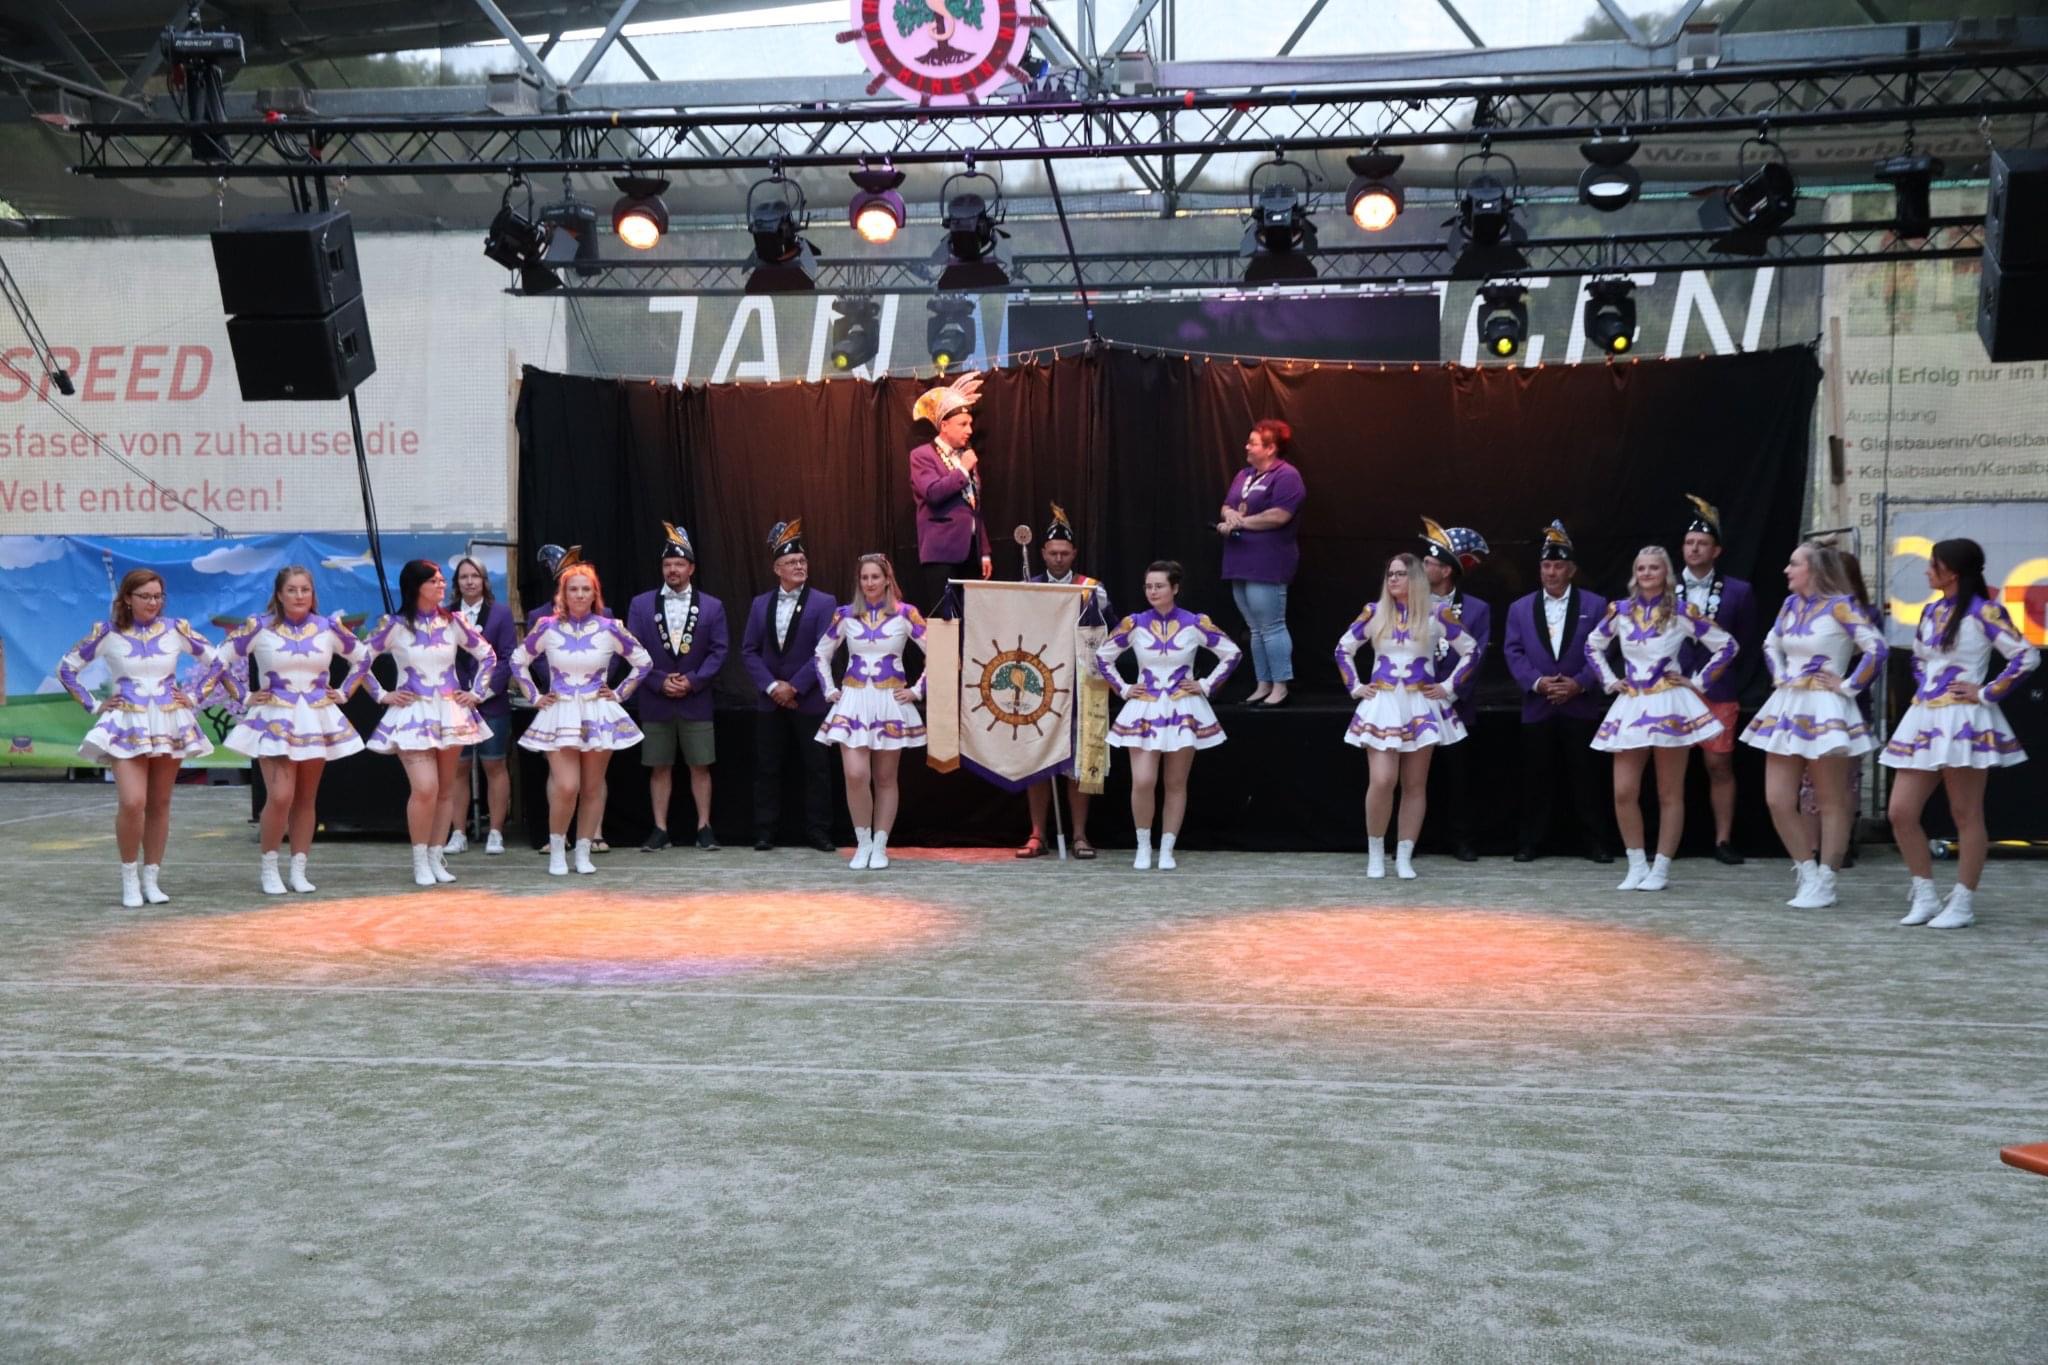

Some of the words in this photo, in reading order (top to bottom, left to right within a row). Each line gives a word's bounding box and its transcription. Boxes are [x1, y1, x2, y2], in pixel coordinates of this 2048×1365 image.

[0, 345, 214, 402] SPEED
[1899, 366, 1960, 387] Erfolg
[1968, 368, 2002, 382] nur
[2009, 367, 2034, 380] im
[119, 432, 182, 456] von
[194, 422, 352, 456] zuhause
[365, 421, 419, 455] die
[1859, 433, 2048, 451] Gleisbauerin/Gleisba
[79, 478, 283, 513] entdecken!
